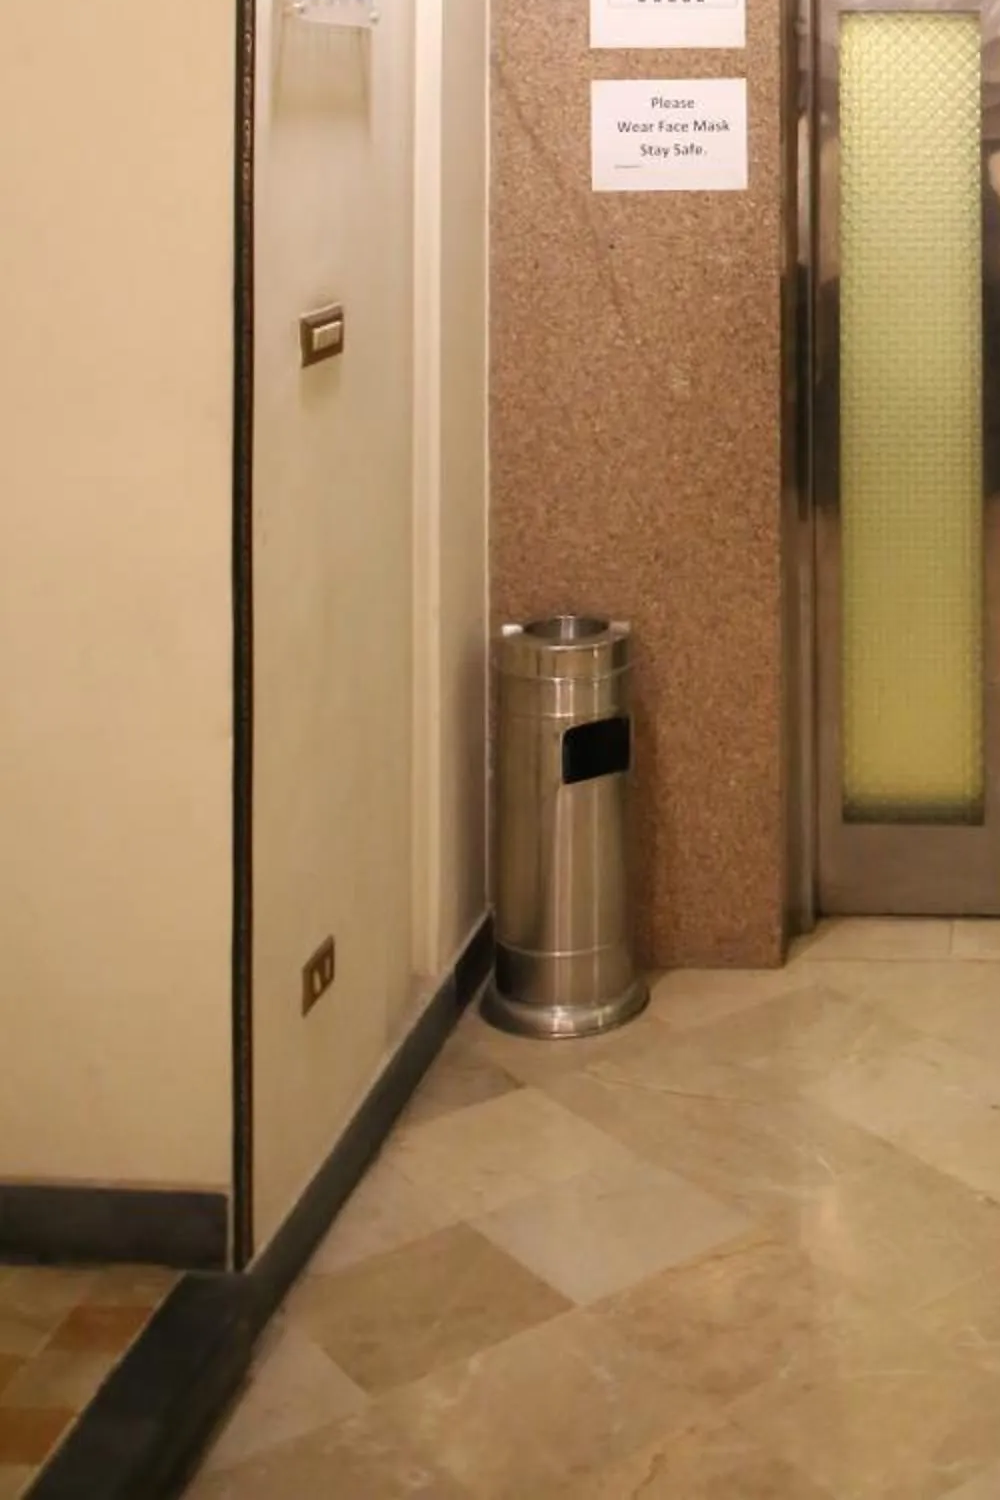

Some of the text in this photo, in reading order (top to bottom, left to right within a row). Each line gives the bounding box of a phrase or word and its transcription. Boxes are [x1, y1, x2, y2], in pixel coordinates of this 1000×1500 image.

[650, 95, 695, 109] Please
[617, 119, 731, 133] Wear Face Mask
[639, 142, 708, 159] Stay Safe.
